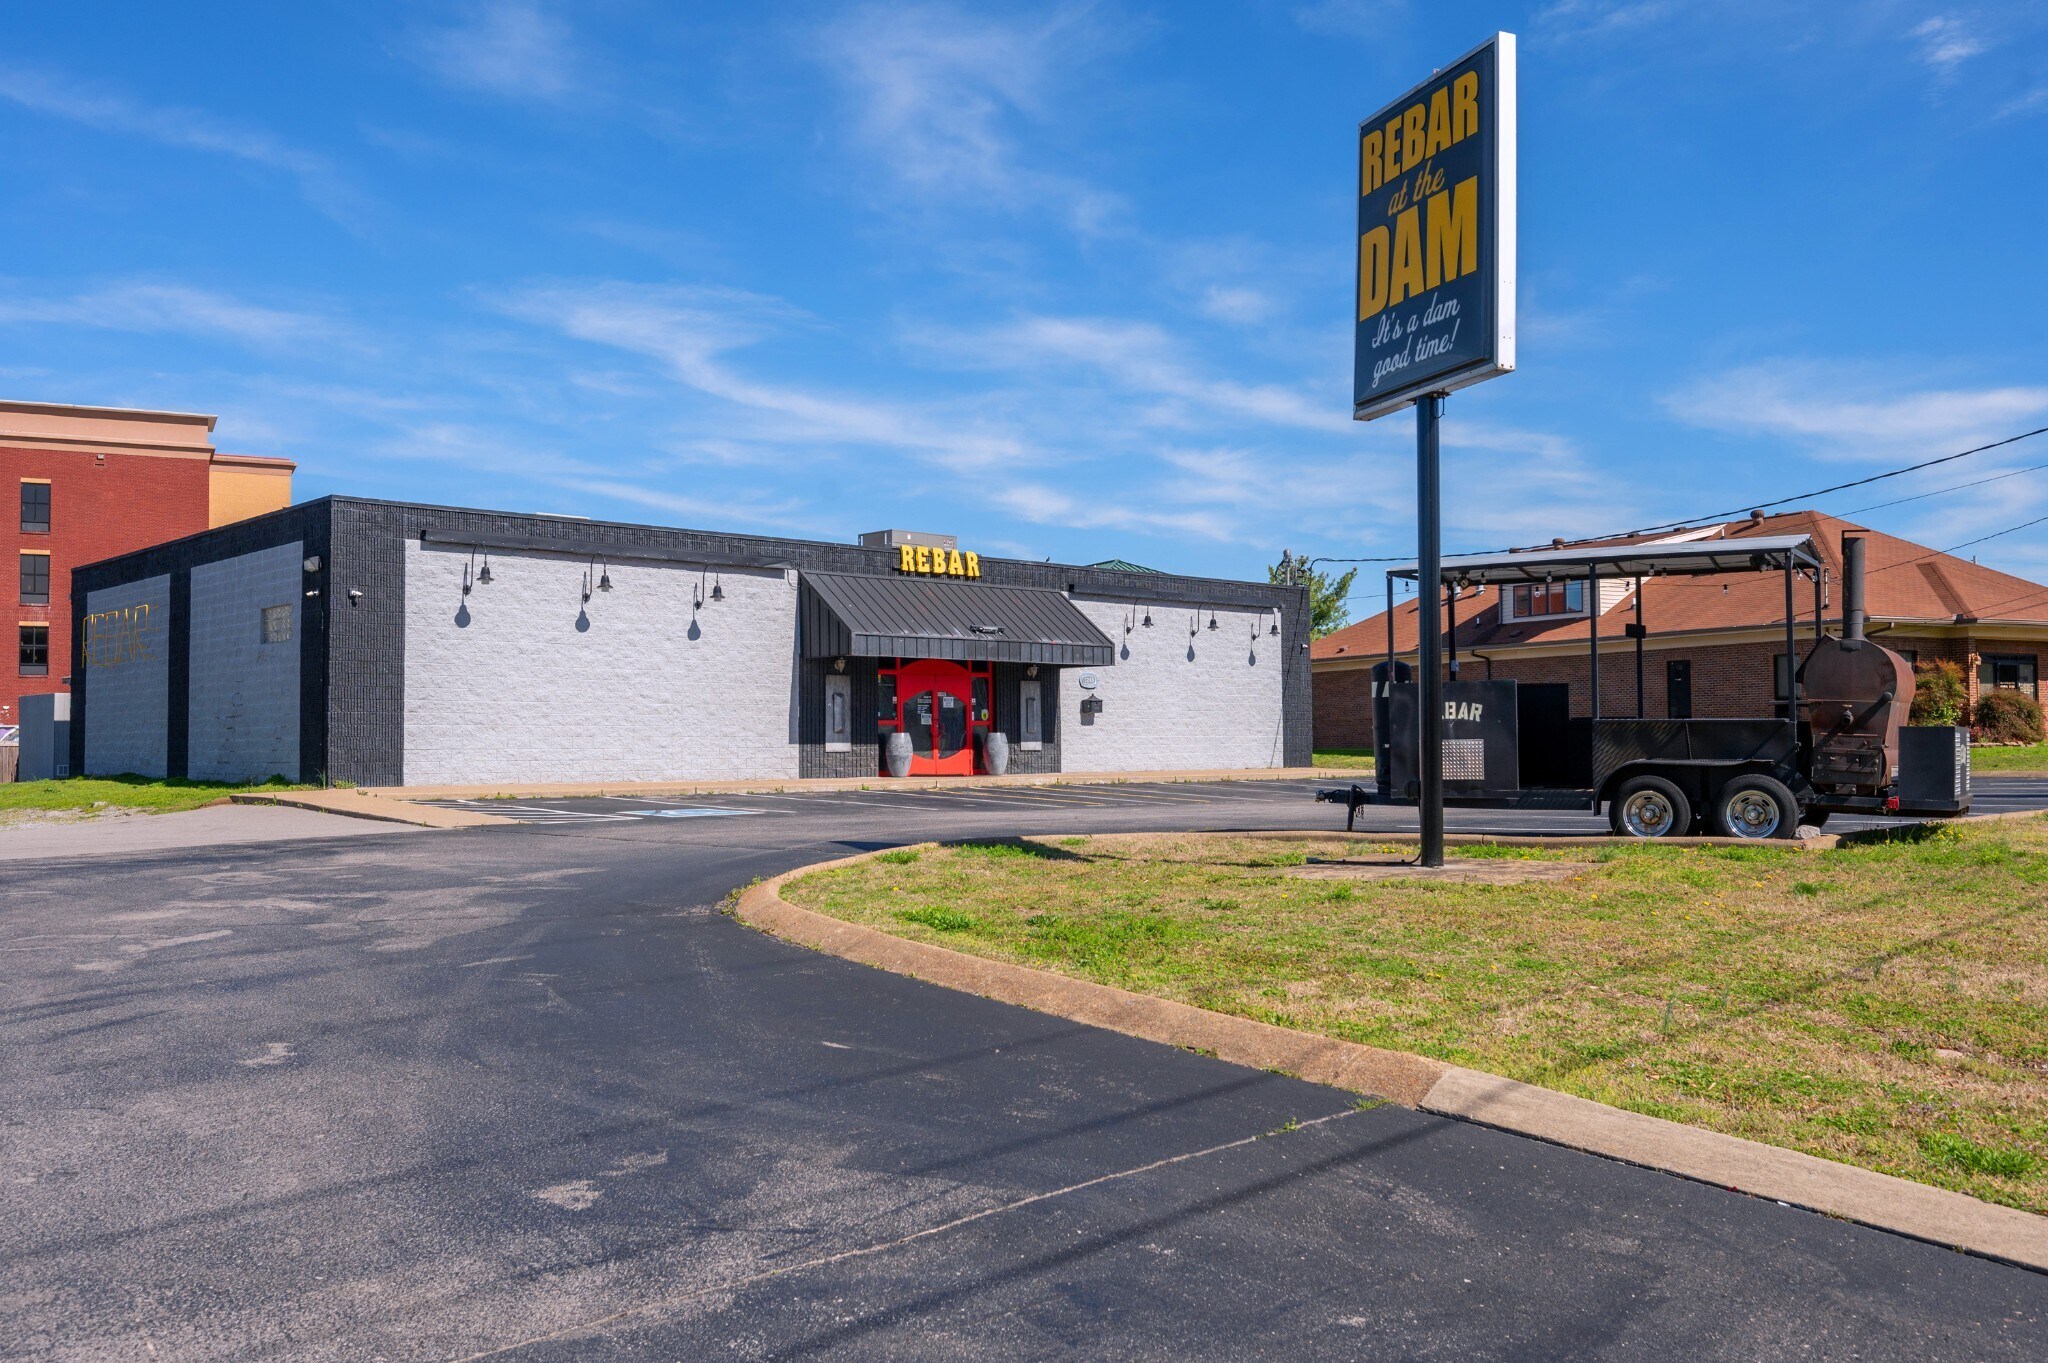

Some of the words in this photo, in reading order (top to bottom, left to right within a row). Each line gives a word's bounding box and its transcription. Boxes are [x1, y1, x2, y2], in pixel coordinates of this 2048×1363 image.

[1362, 70, 1479, 197] REBAR
[1388, 179, 1408, 217] at
[1412, 159, 1445, 203] the
[1360, 175, 1478, 322] DAM
[1372, 312, 1403, 349] It's
[1406, 314, 1419, 334] a
[1422, 291, 1461, 327] dam
[1371, 334, 1413, 389] good
[1414, 317, 1461, 363] time!
[900, 544, 981, 578] REBAR
[1441, 701, 1483, 722] BAR
